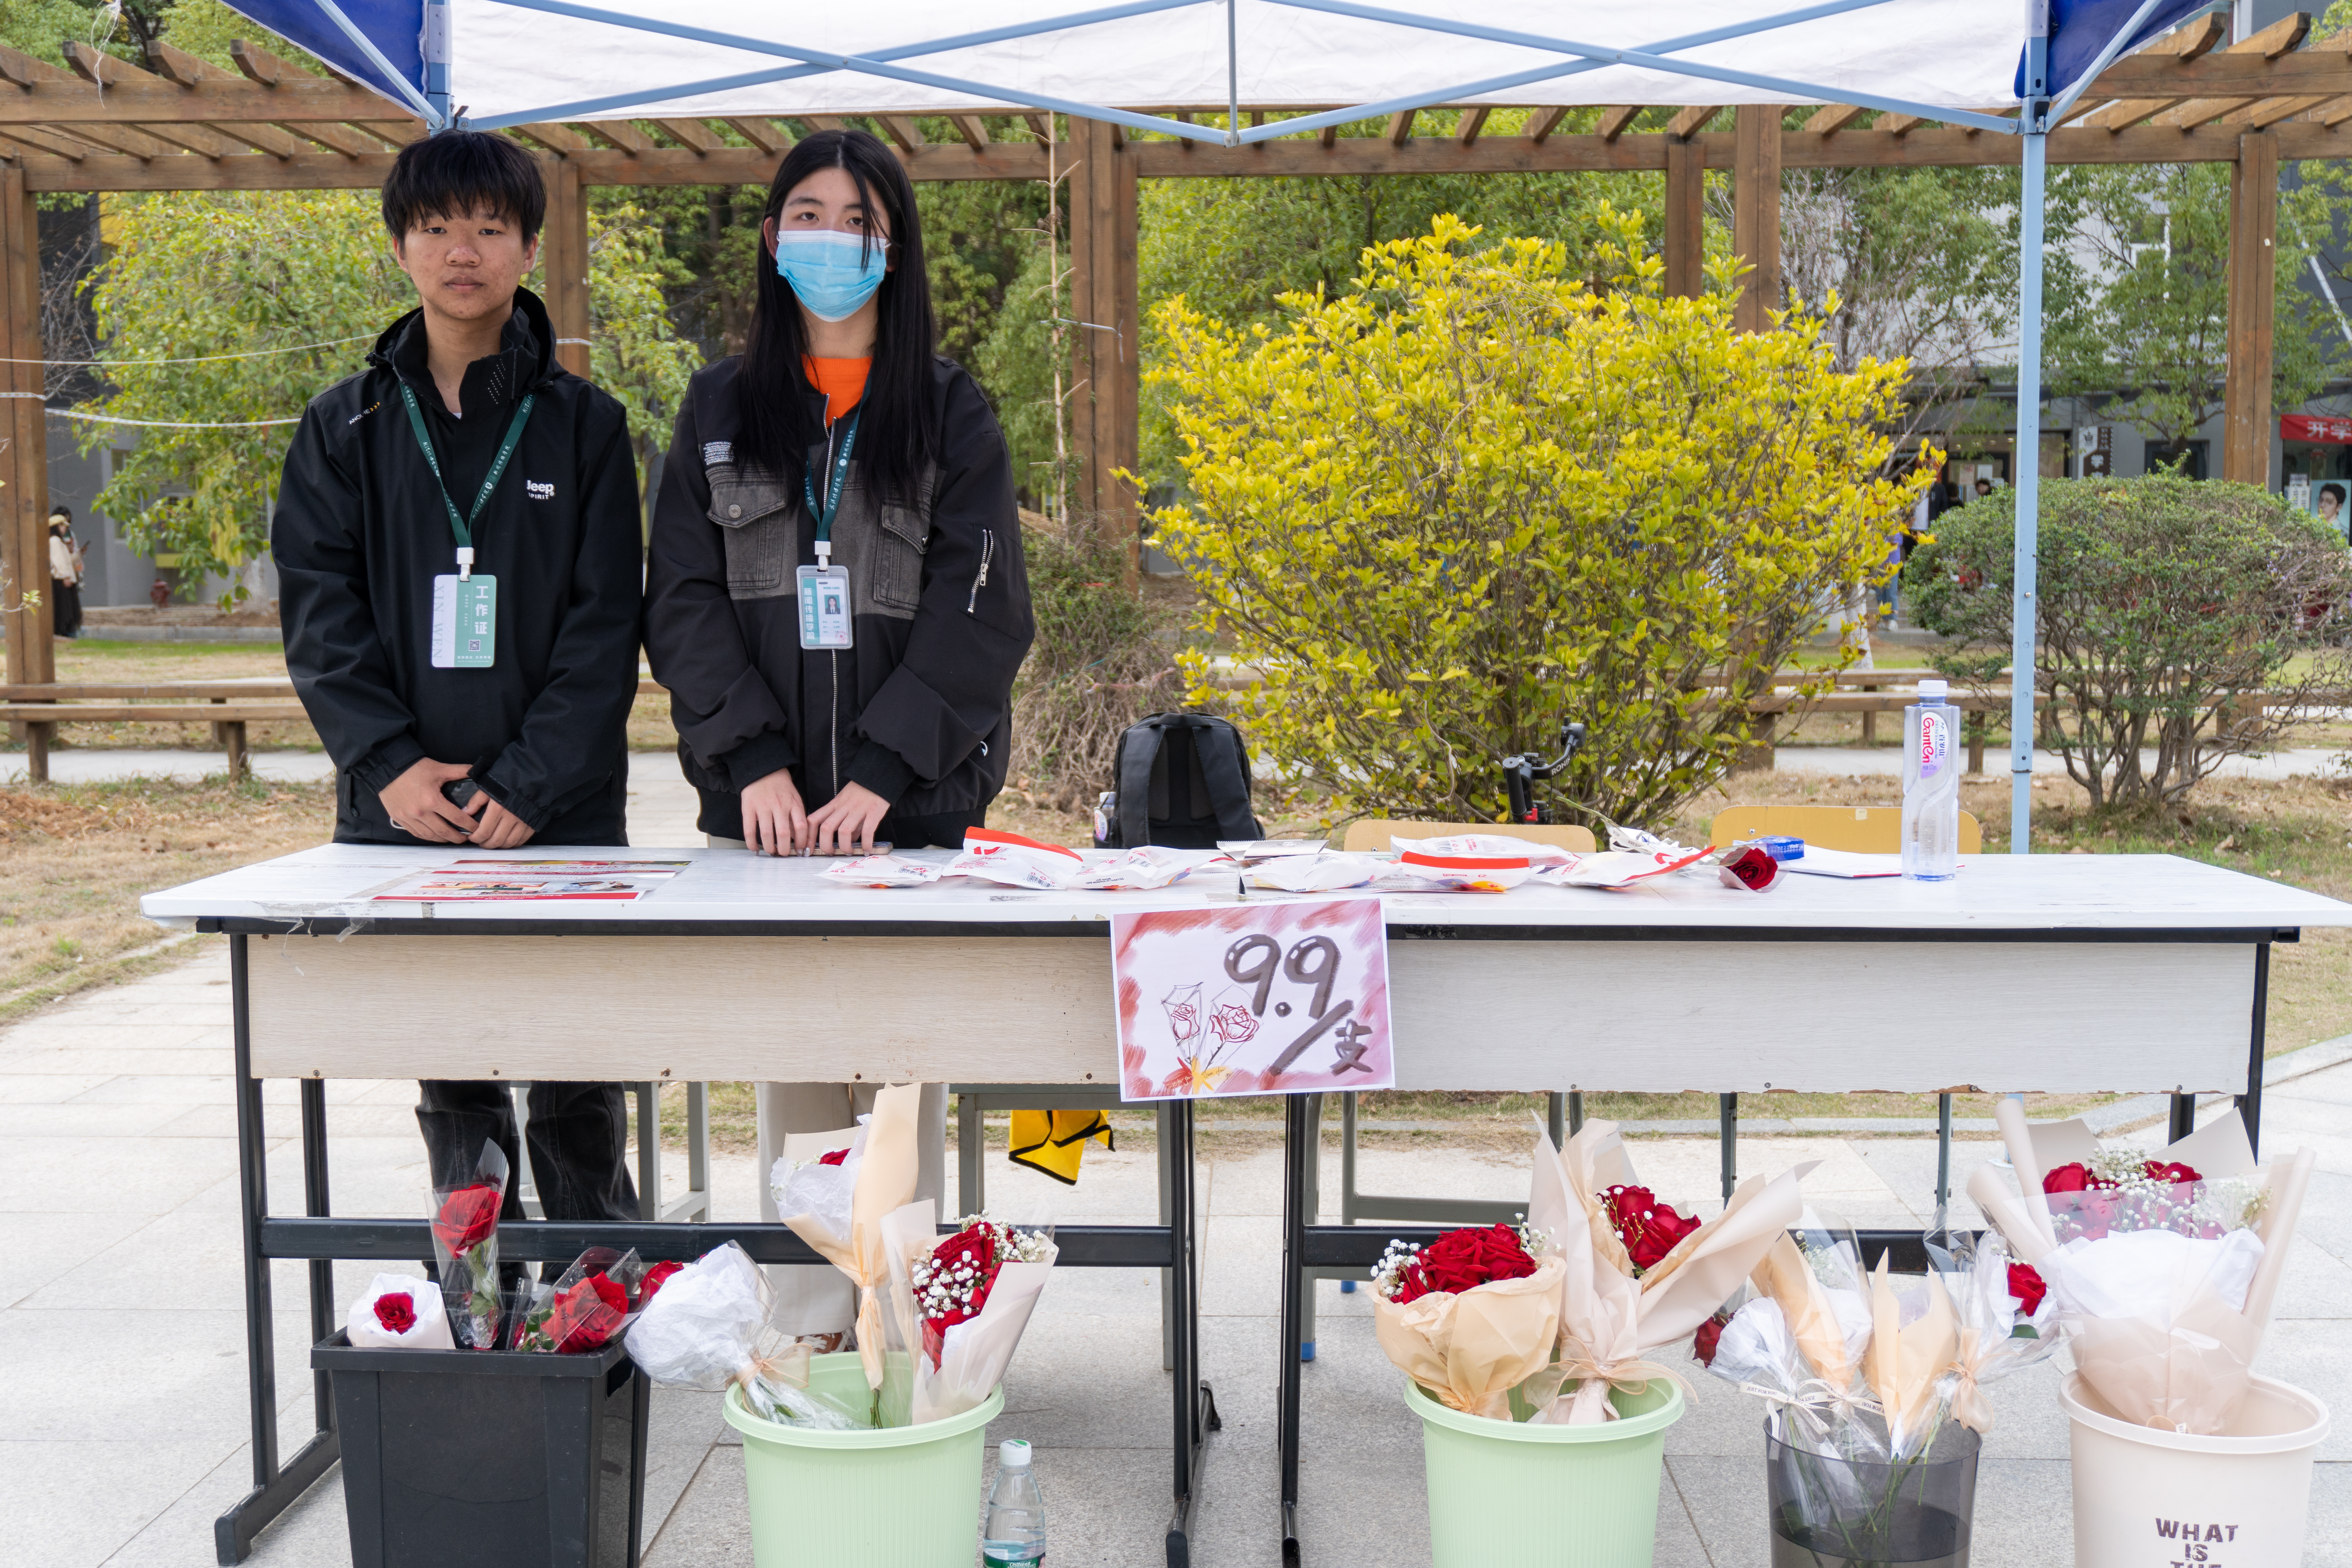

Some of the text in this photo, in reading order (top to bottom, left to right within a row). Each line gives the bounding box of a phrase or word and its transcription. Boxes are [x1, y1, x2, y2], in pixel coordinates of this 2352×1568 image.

[2307, 421, 2352, 441] 开学
[527, 480, 554, 494] Jeep
[432, 584, 444, 658] XIN WEN
[475, 586, 488, 634] 工作证
[804, 588, 815, 639] 新闻传播学院
[1552, 755, 1570, 775] RONIN
[2155, 1518, 2238, 1543] WHAT
[2185, 1543, 2208, 1561] IS
